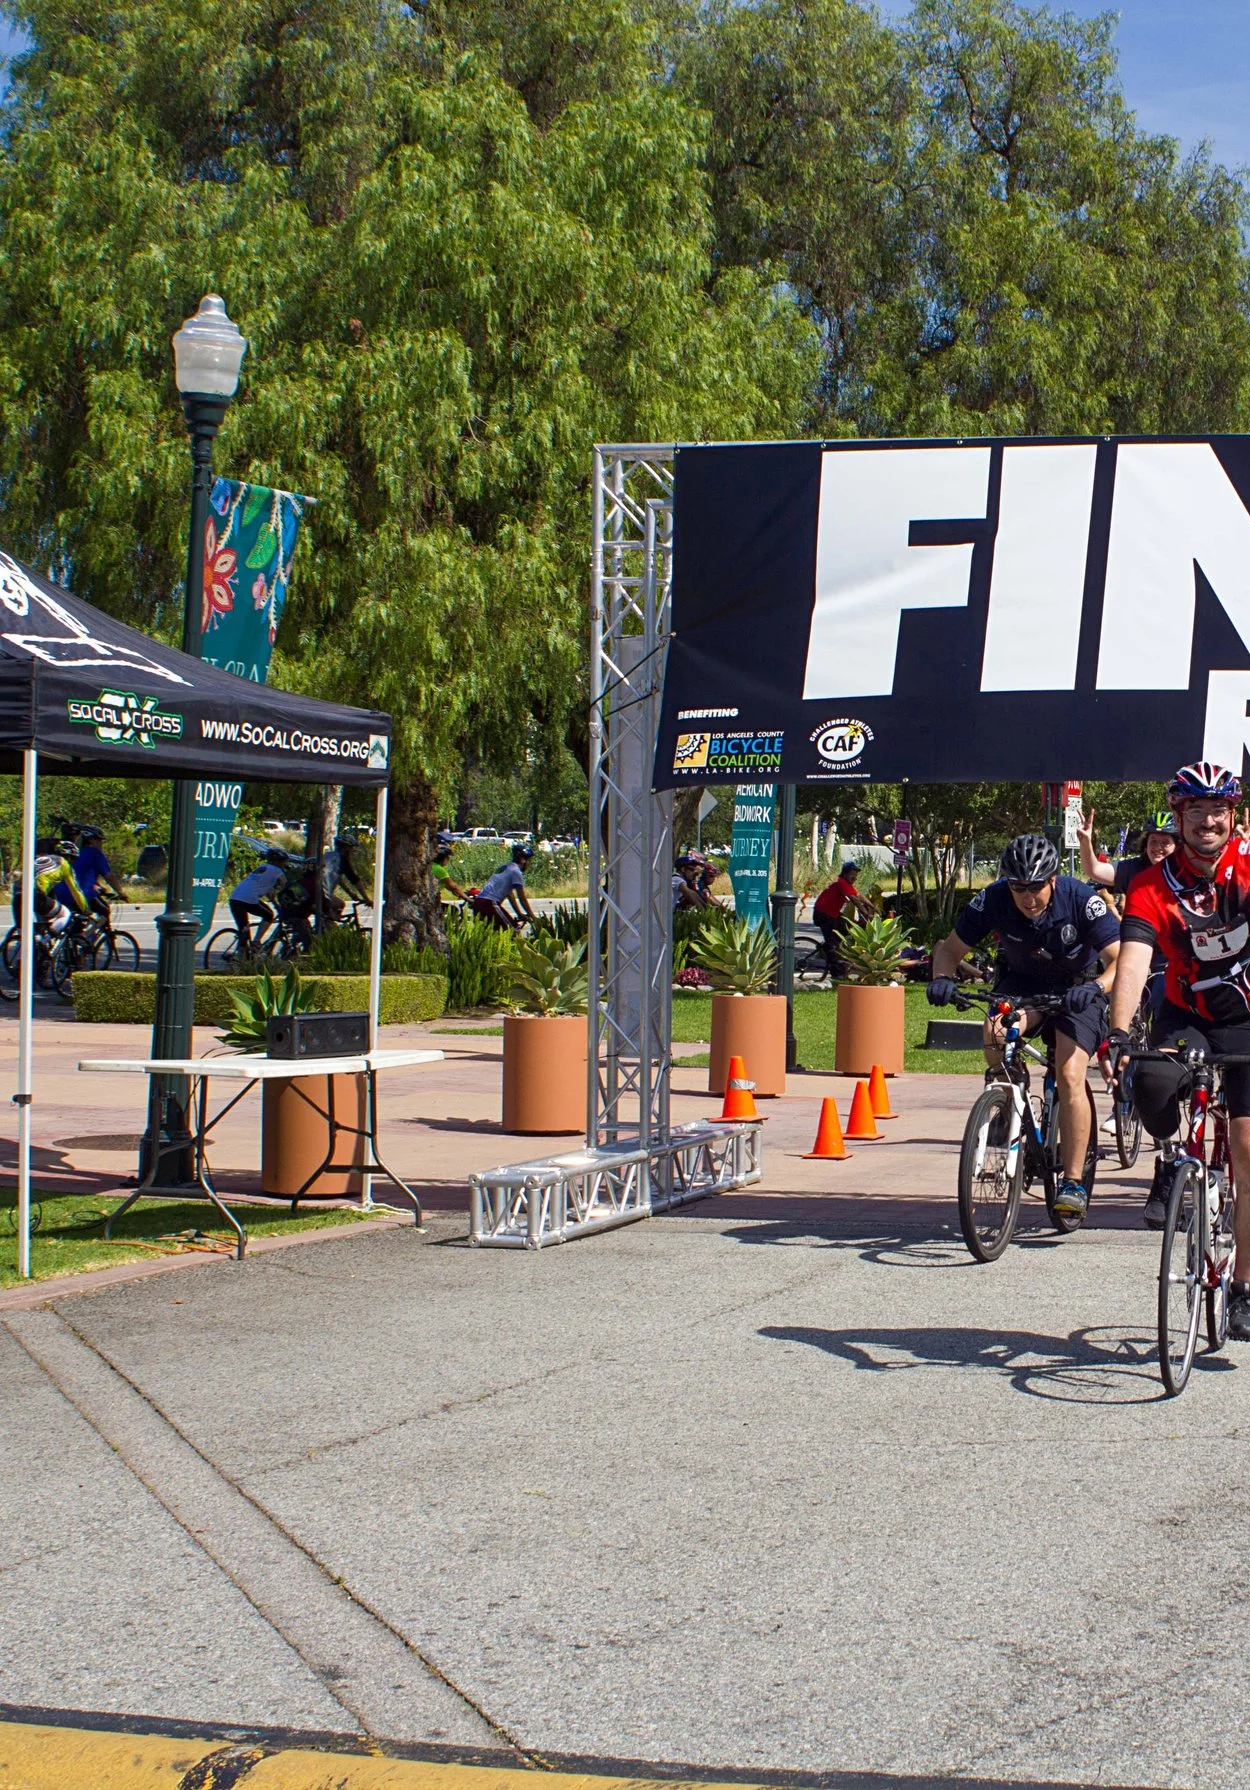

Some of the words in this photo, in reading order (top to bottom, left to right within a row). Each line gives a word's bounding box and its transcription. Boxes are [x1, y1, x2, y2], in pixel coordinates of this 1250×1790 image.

[678, 708, 739, 720] BENEFITING
[132, 711, 181, 734] CROSS
[809, 718, 850, 742] CHALLENGED
[849, 719, 875, 741] ATHLETES
[710, 738, 783, 754] BICYCLE
[822, 735, 860, 752] CAF
[709, 754, 781, 767] COALITION
[818, 758, 862, 770] FOUNDATION
[673, 766, 780, 775] WWW.LA-BIKE.ORG
[195, 782, 242, 809] ADWO
[1218, 935, 1231, 953] 1
